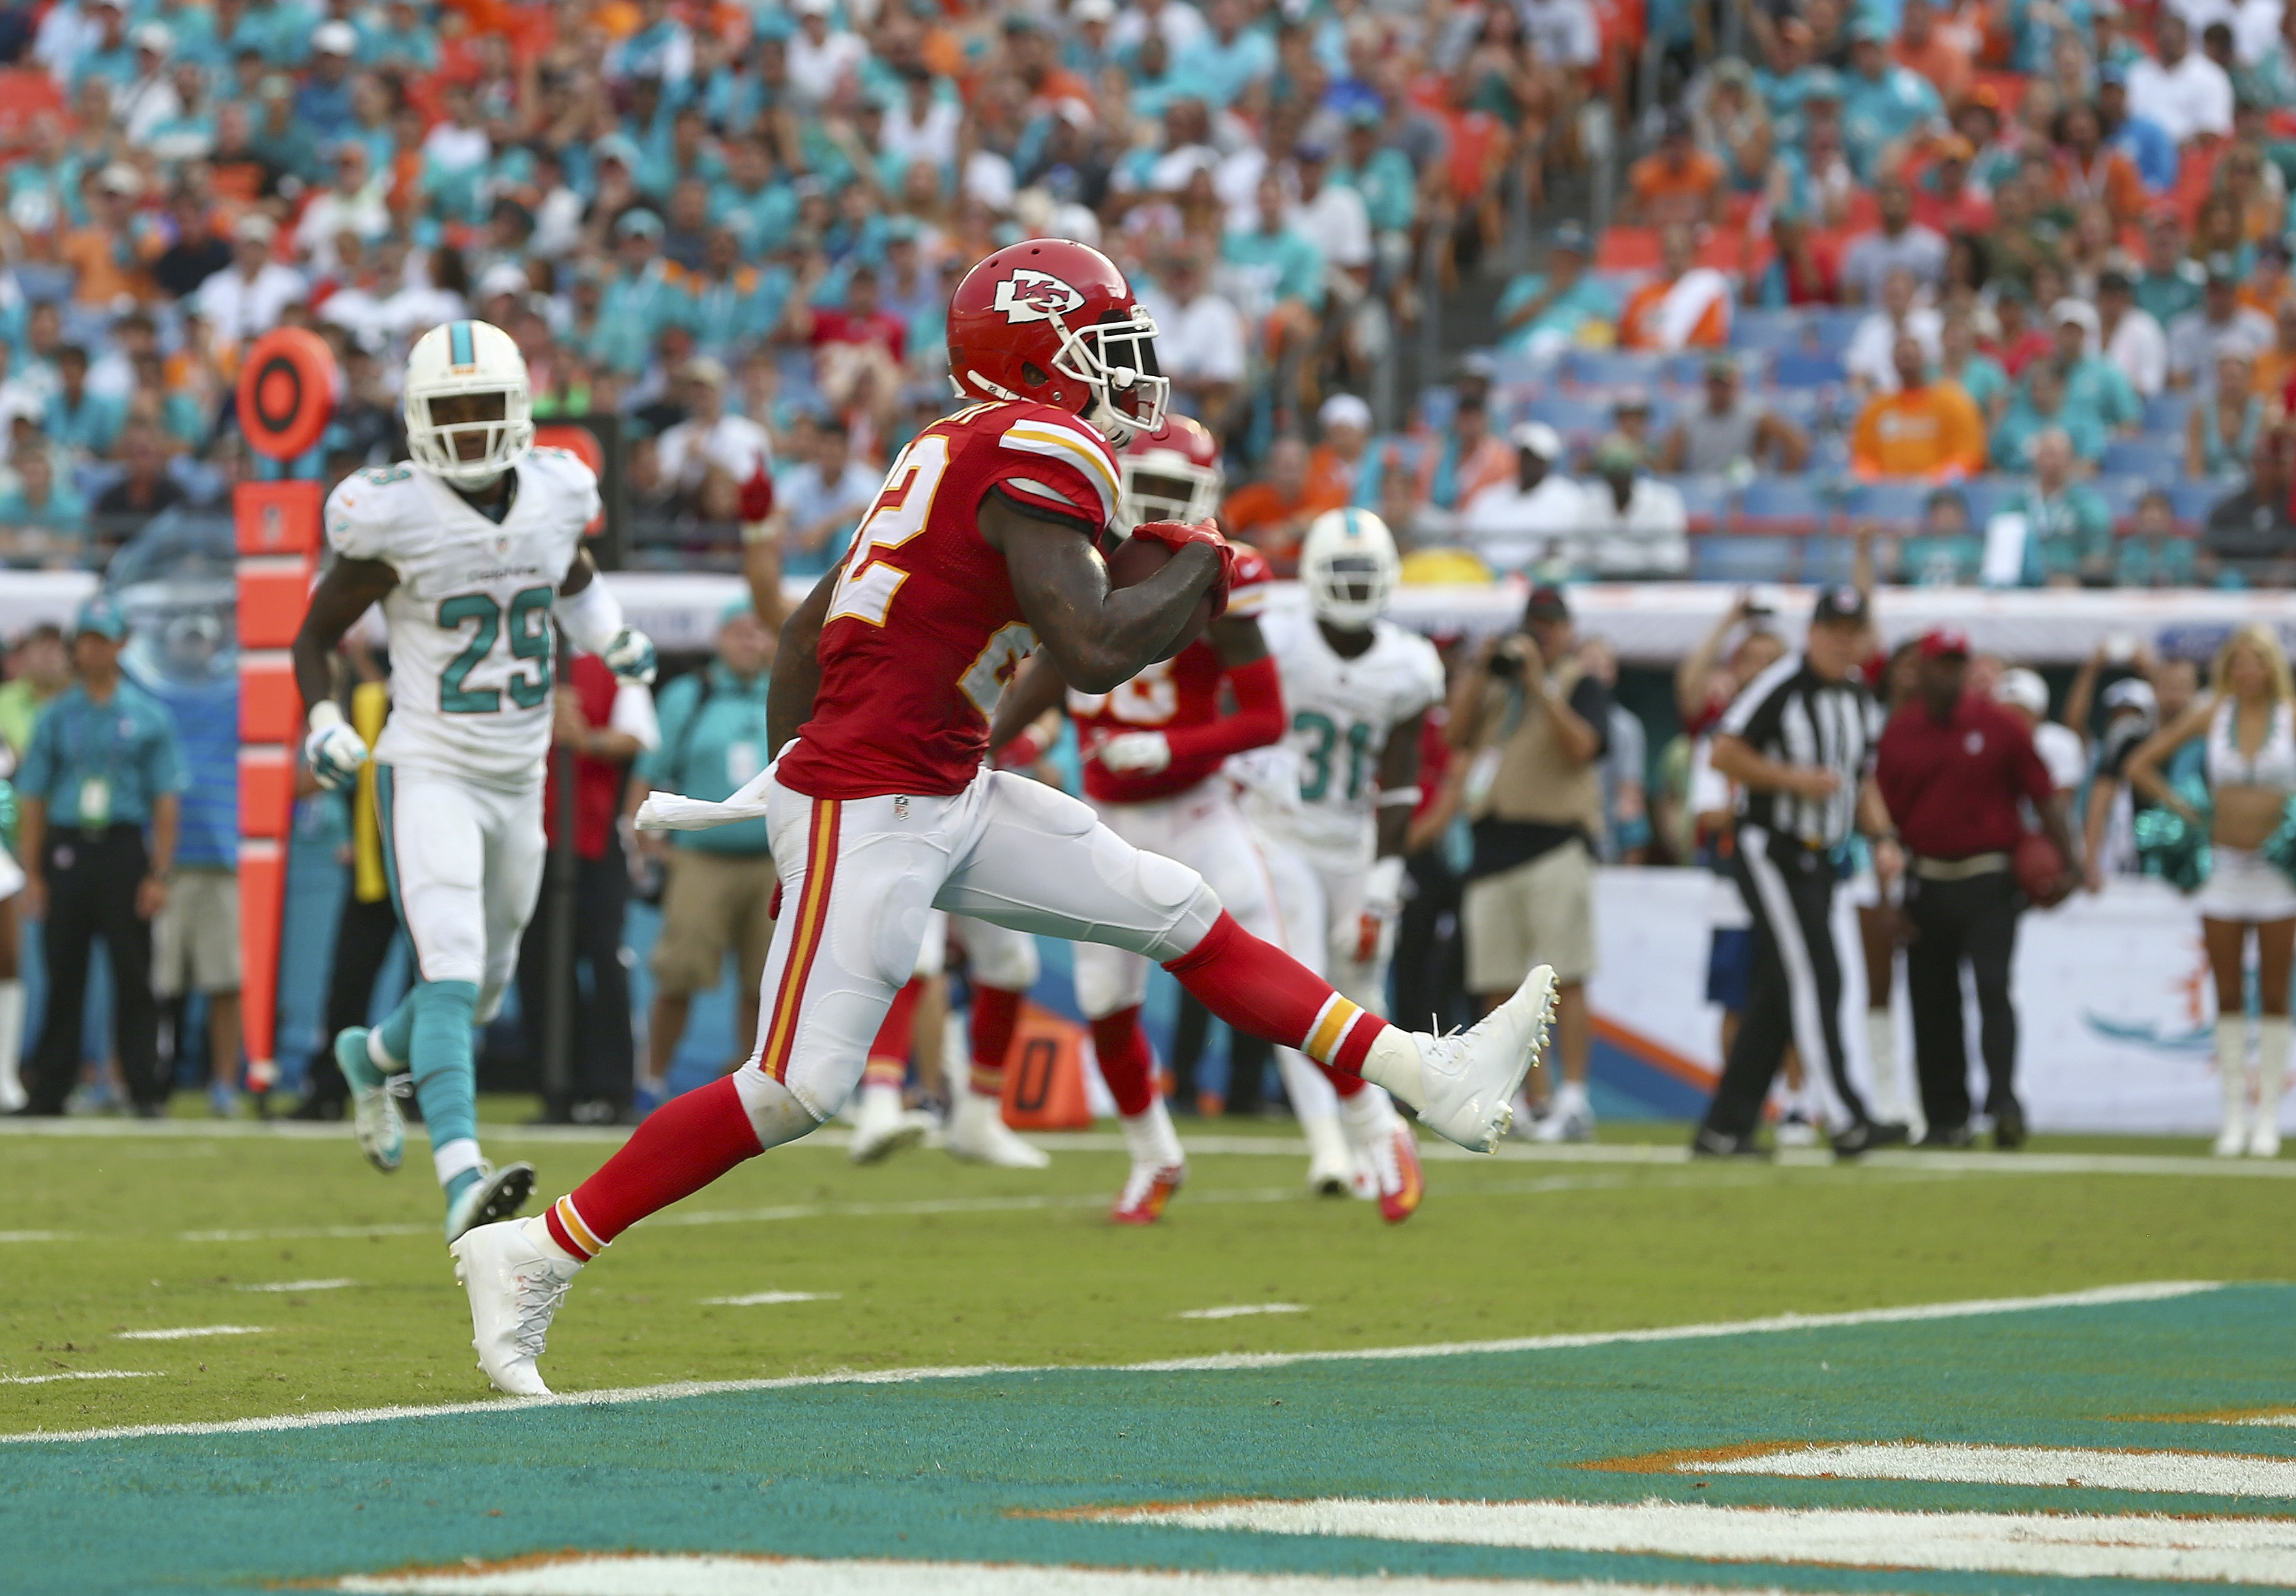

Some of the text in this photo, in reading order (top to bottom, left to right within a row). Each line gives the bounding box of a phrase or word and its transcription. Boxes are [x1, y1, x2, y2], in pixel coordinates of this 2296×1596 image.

[1012, 279, 1070, 314] KC
[822, 433, 951, 628] 2
[436, 584, 554, 715] 29
[1065, 656, 1180, 726] 8
[1292, 708, 1372, 803] 31
[1014, 1037, 1057, 1112] 0
